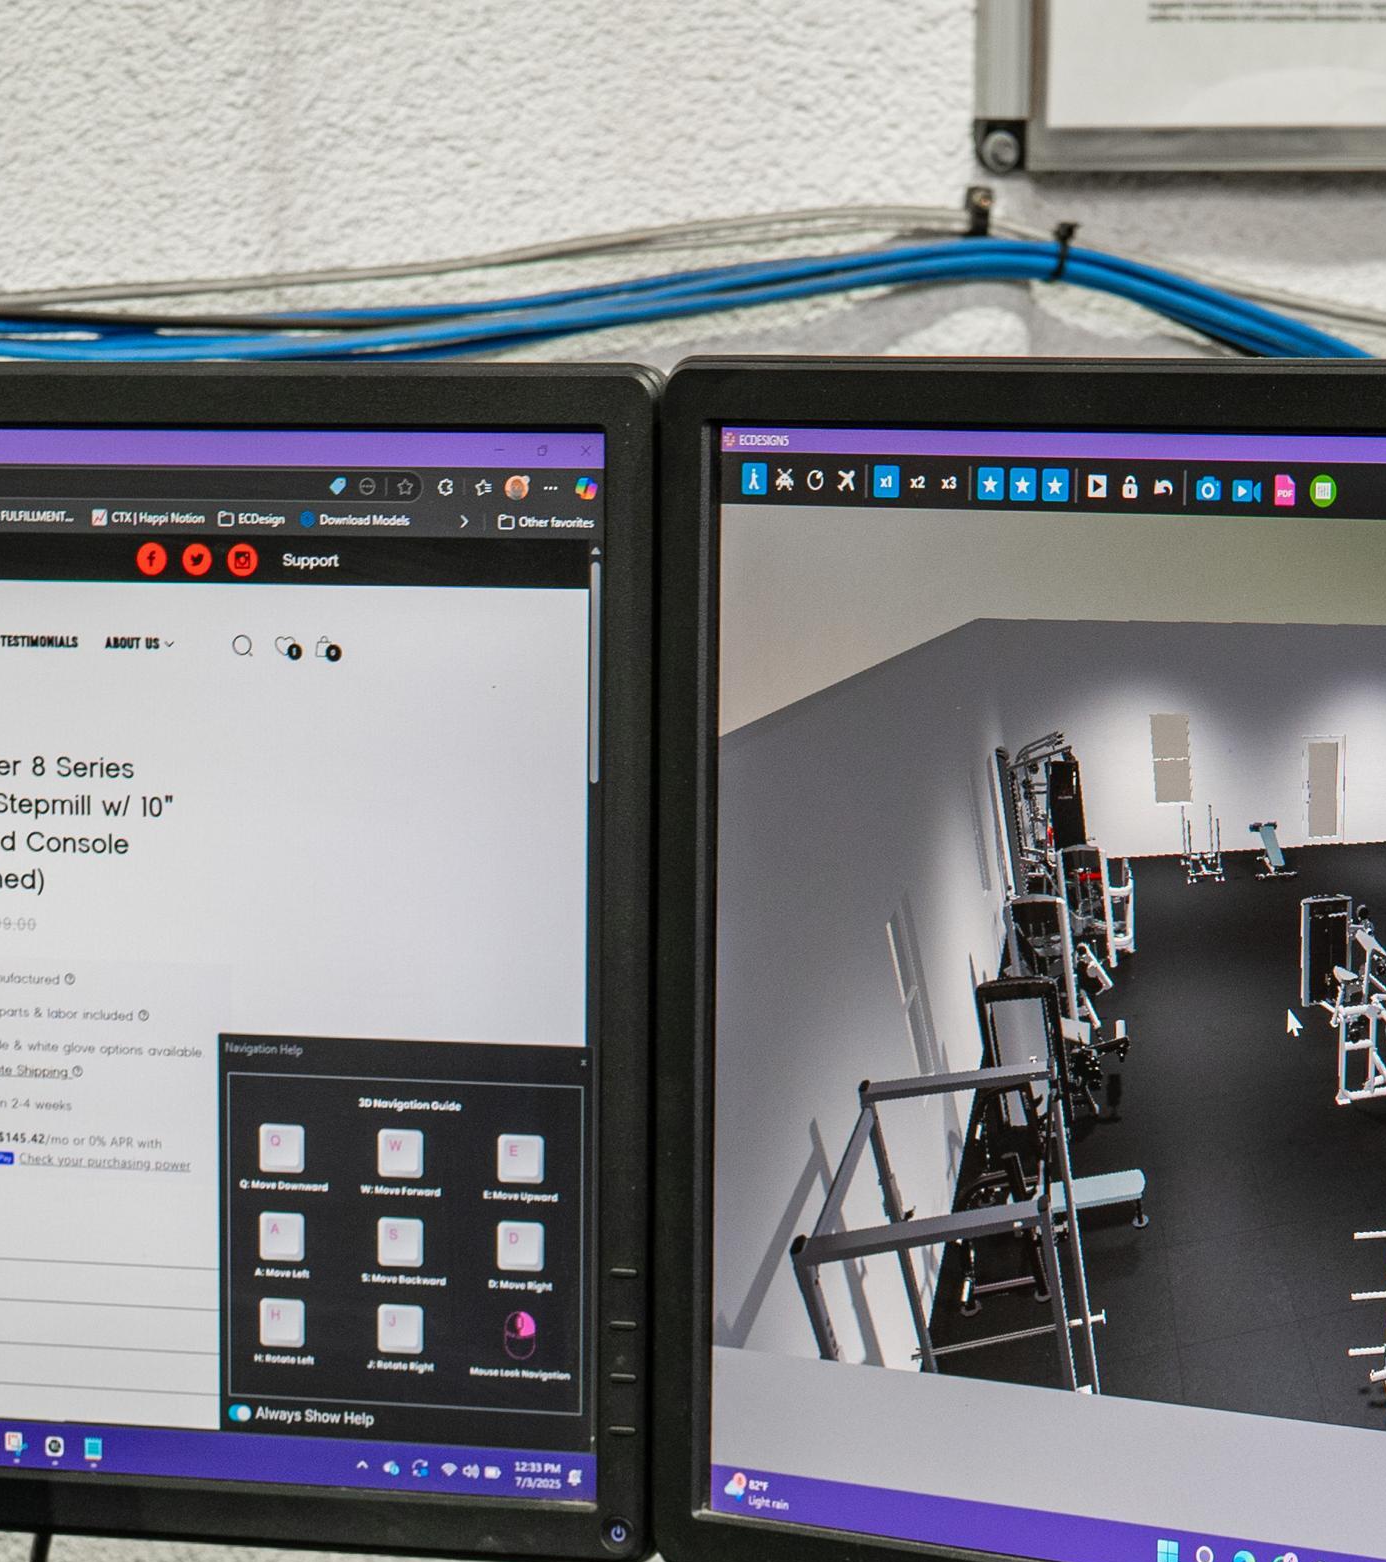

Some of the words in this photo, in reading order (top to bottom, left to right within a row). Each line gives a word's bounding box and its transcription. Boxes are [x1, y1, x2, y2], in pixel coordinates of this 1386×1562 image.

[910, 477, 925, 489] x2
[941, 477, 957, 489] x3
[1277, 489, 1294, 498] PDF
[171, 513, 205, 524] Notion
[238, 513, 284, 526] ECDesign
[320, 514, 370, 526] Download
[372, 515, 410, 526] Models
[519, 517, 547, 528] Other
[550, 517, 594, 528] favorites
[283, 554, 338, 569] Support
[0, 635, 78, 649] TESTIMONIALS
[105, 637, 140, 649] ABOUT
[145, 638, 159, 649] US
[32, 756, 45, 775] 8
[57, 757, 134, 779] Series
[103, 796, 130, 816] w/
[142, 795, 173, 817] 10"
[27, 832, 129, 854] Console
[47, 1007, 77, 1020] labor
[83, 1009, 133, 1021] included
[27, 1041, 58, 1053] white
[63, 1042, 94, 1055] glove
[99, 1043, 143, 1057] options
[225, 1042, 277, 1055] Navigation
[280, 1044, 303, 1057] Help
[17, 1064, 67, 1079] Shipping
[35, 1099, 72, 1111] weeks
[373, 1098, 429, 1112] Navigation
[431, 1101, 461, 1112] Guide
[73, 1136, 85, 1145] or
[110, 1136, 133, 1148] APR
[137, 1137, 162, 1149] with
[20, 1153, 53, 1165] Check
[58, 1156, 83, 1168] your
[88, 1156, 151, 1171] purchasing
[156, 1160, 191, 1172] power
[255, 1406, 301, 1423] Always
[305, 1409, 340, 1424] Show
[344, 1412, 374, 1427] Help
[515, 1461, 541, 1473] 12:33
[544, 1463, 561, 1474] PM
[515, 1476, 561, 1489] 7/3/2025
[749, 1496, 770, 1510] Light
[772, 1499, 789, 1510] rain
